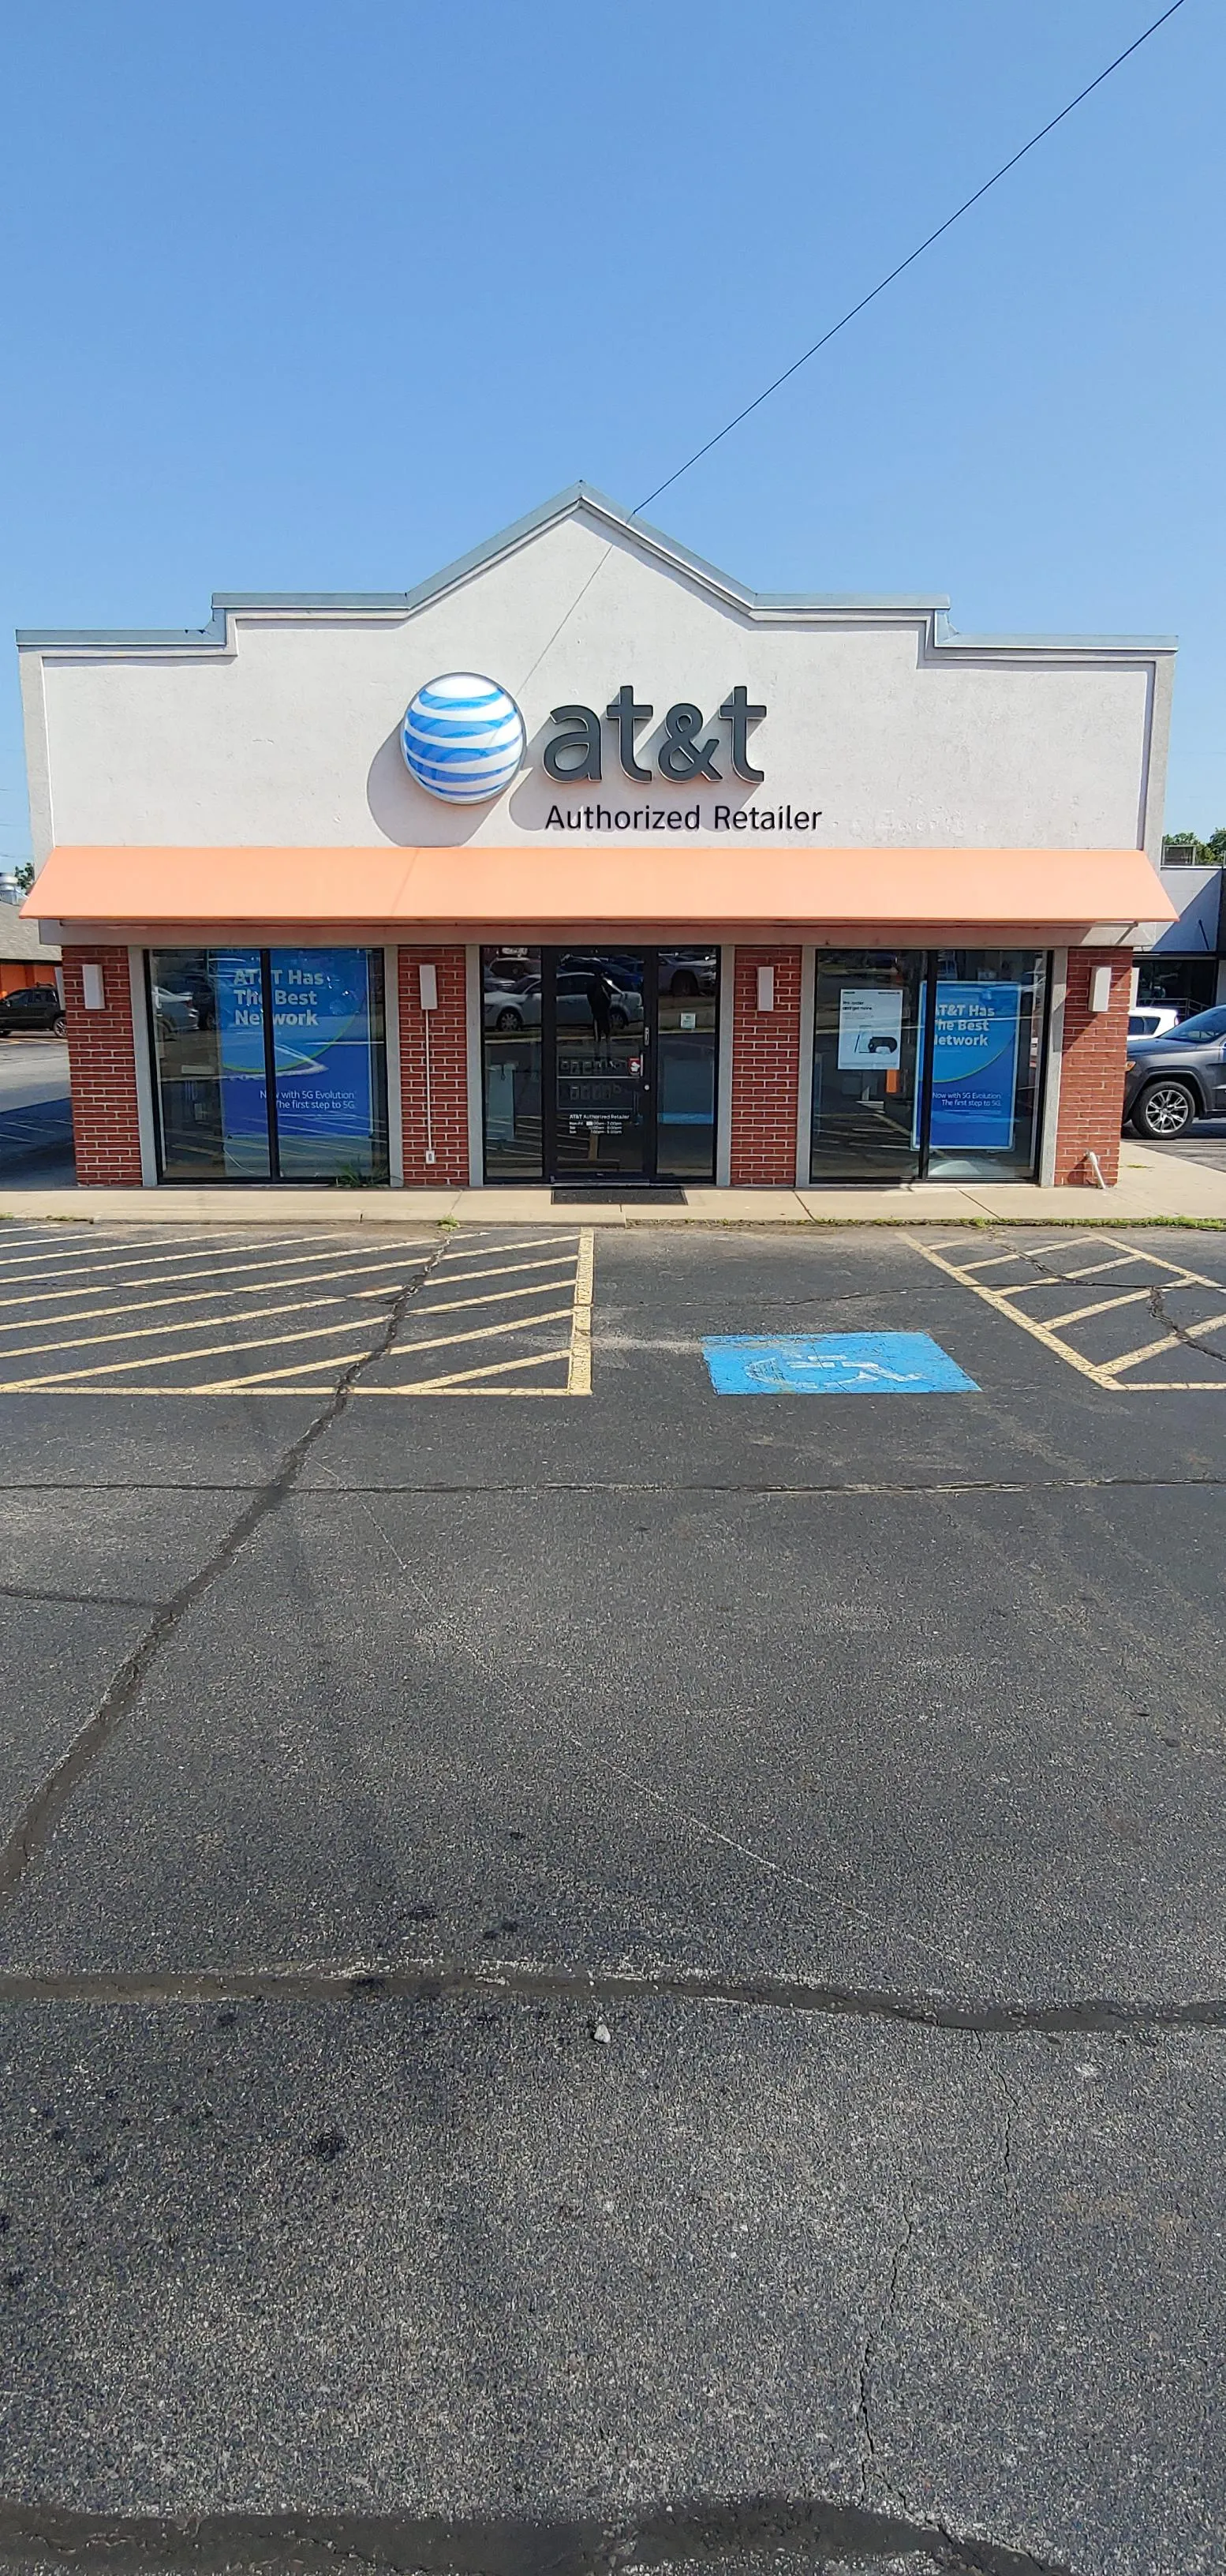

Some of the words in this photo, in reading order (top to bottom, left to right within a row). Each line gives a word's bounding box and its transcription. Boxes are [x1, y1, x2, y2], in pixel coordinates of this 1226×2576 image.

[542, 684, 768, 784] at&t
[544, 804, 701, 831] Authorized
[714, 805, 823, 831] Retailer
[233, 968, 282, 986] ATT
[288, 969, 324, 986] Has
[275, 990, 318, 1005] Best
[235, 1009, 319, 1026] Nework
[936, 1004, 966, 1017] T&T
[969, 1004, 996, 1017] Has
[958, 1019, 990, 1032] Best
[281, 1090, 300, 1099] with
[301, 1090, 313, 1099] 5G
[292, 1100, 310, 1109] first
[311, 1101, 331, 1110] step
